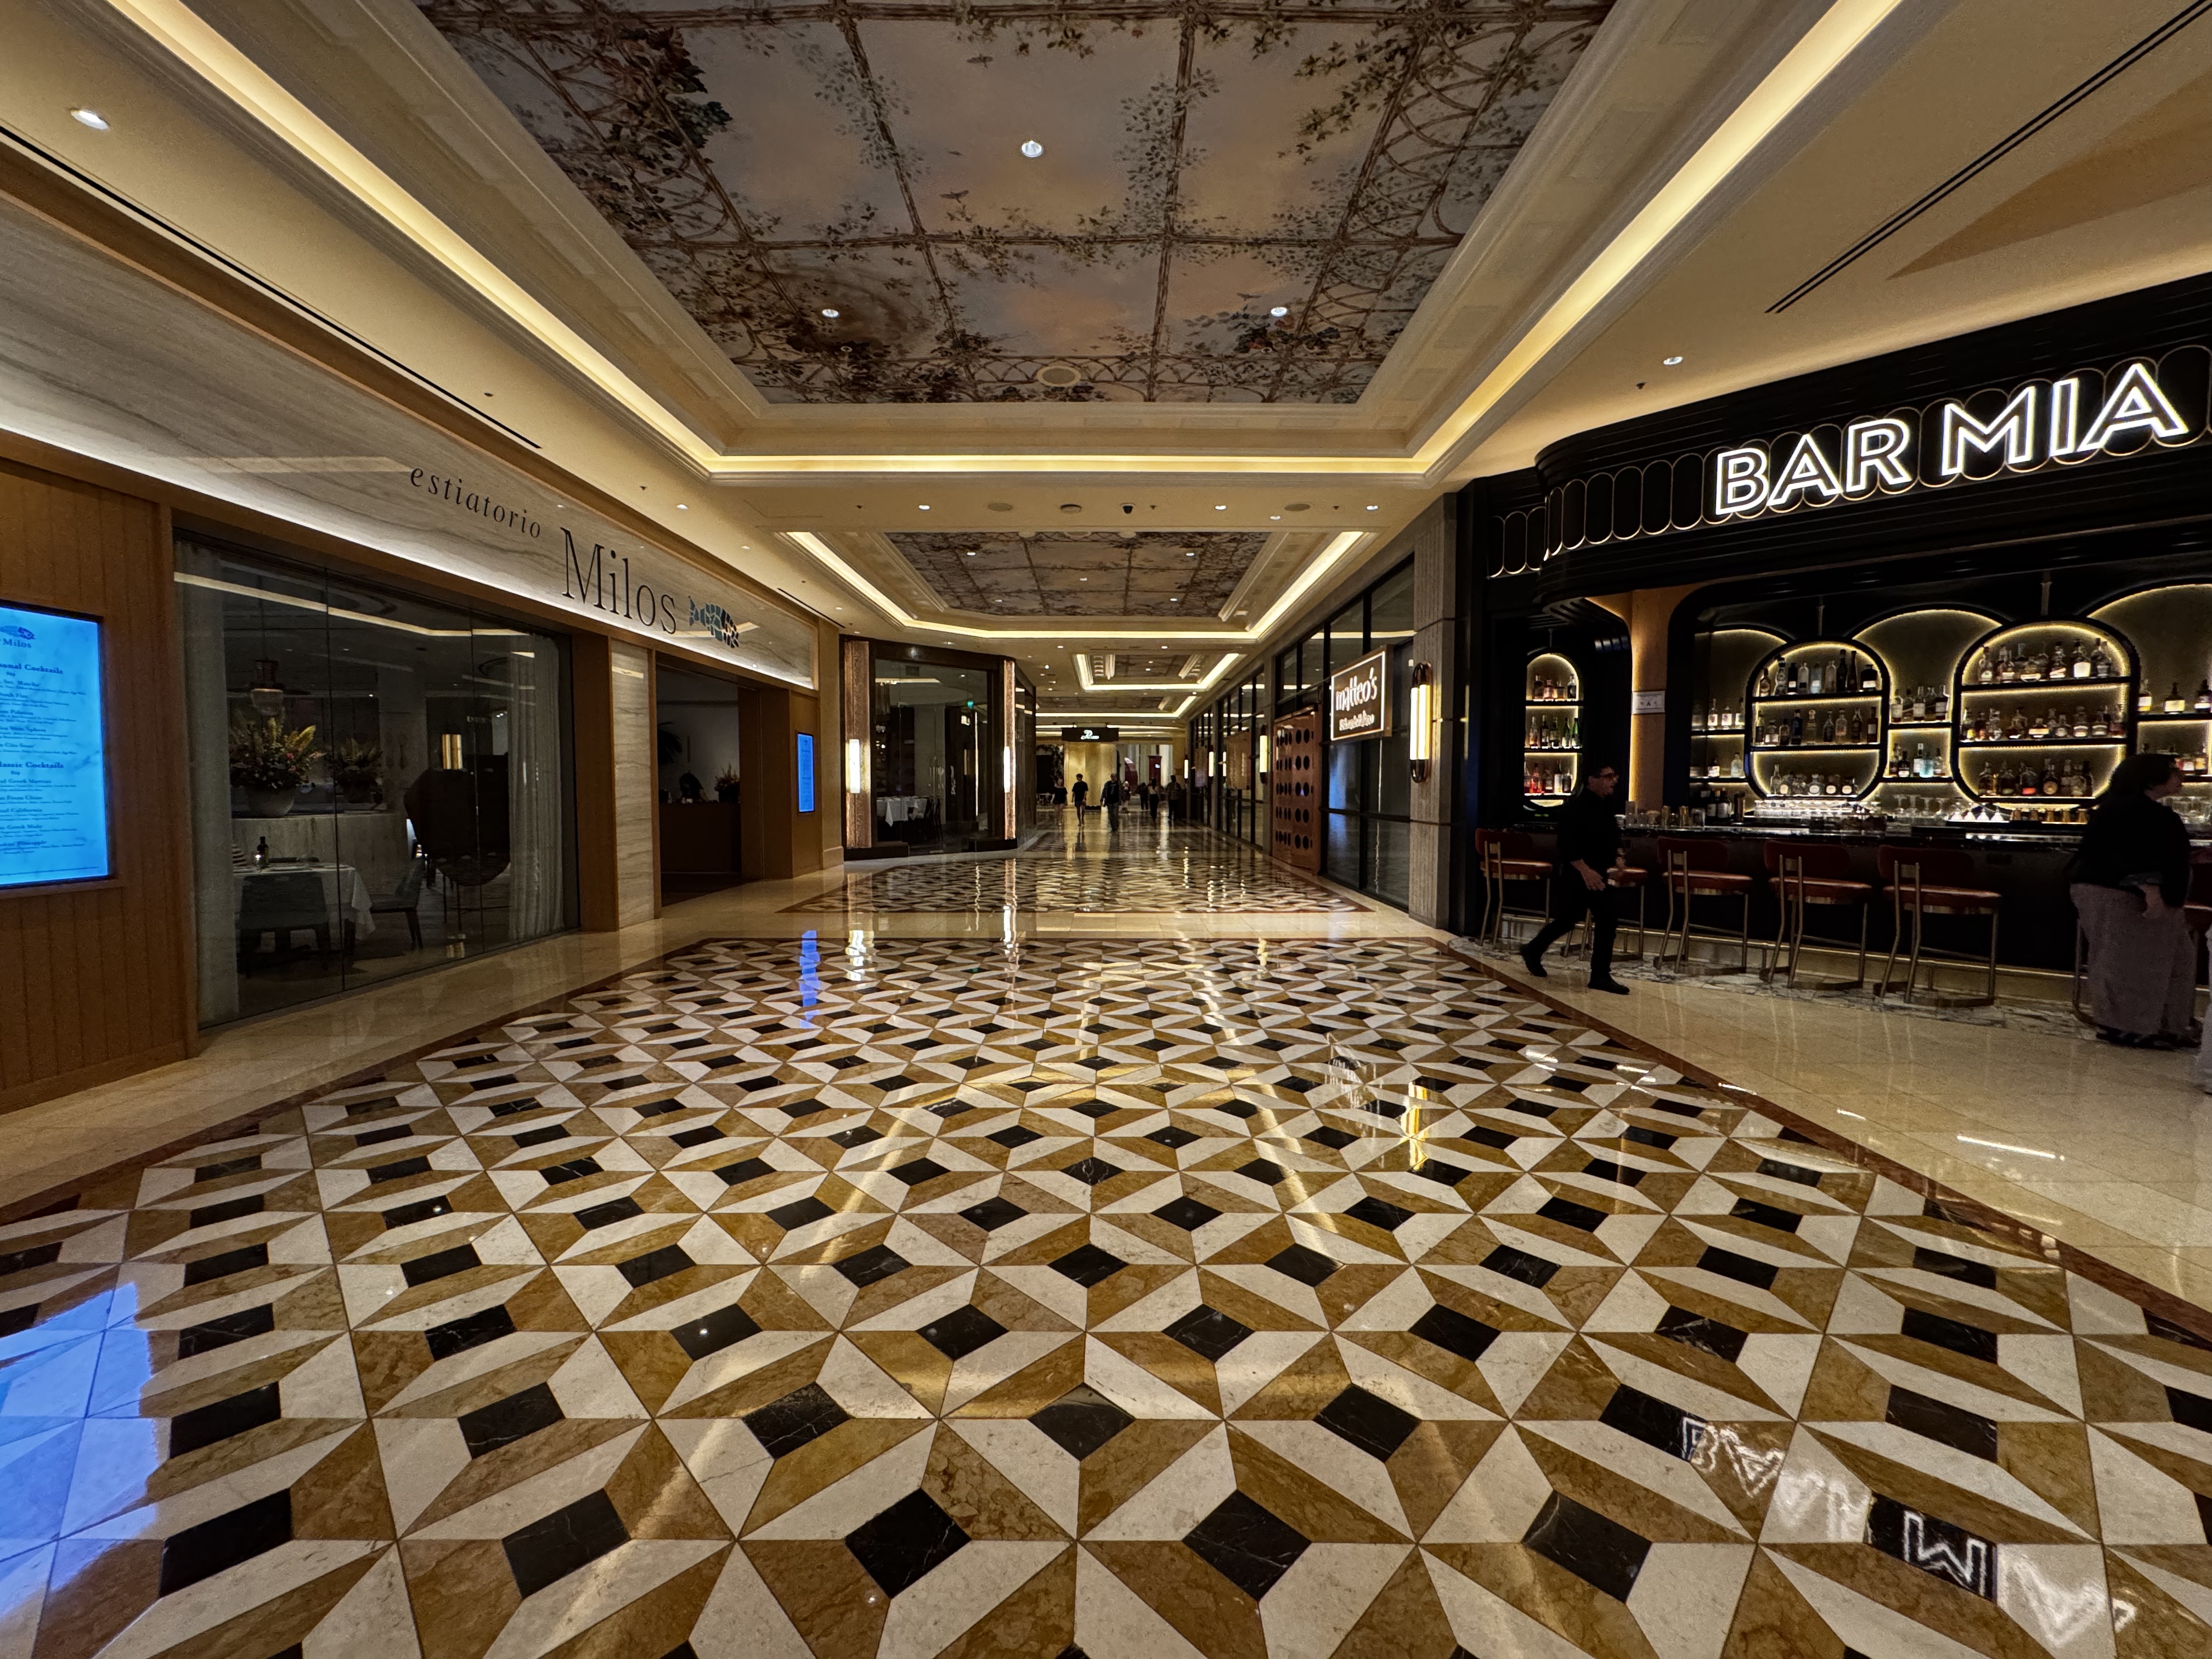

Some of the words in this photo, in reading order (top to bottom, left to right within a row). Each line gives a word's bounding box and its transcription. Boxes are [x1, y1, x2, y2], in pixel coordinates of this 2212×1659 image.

[1715, 417, 1912, 516] BAR
[1940, 362, 2189, 477] MIA
[410, 466, 541, 538] estiatorio
[560, 527, 676, 634] Milos
[3, 638, 32, 648] Milos
[24, 664, 63, 674] Cocktails
[1335, 667, 1378, 712] matteo's
